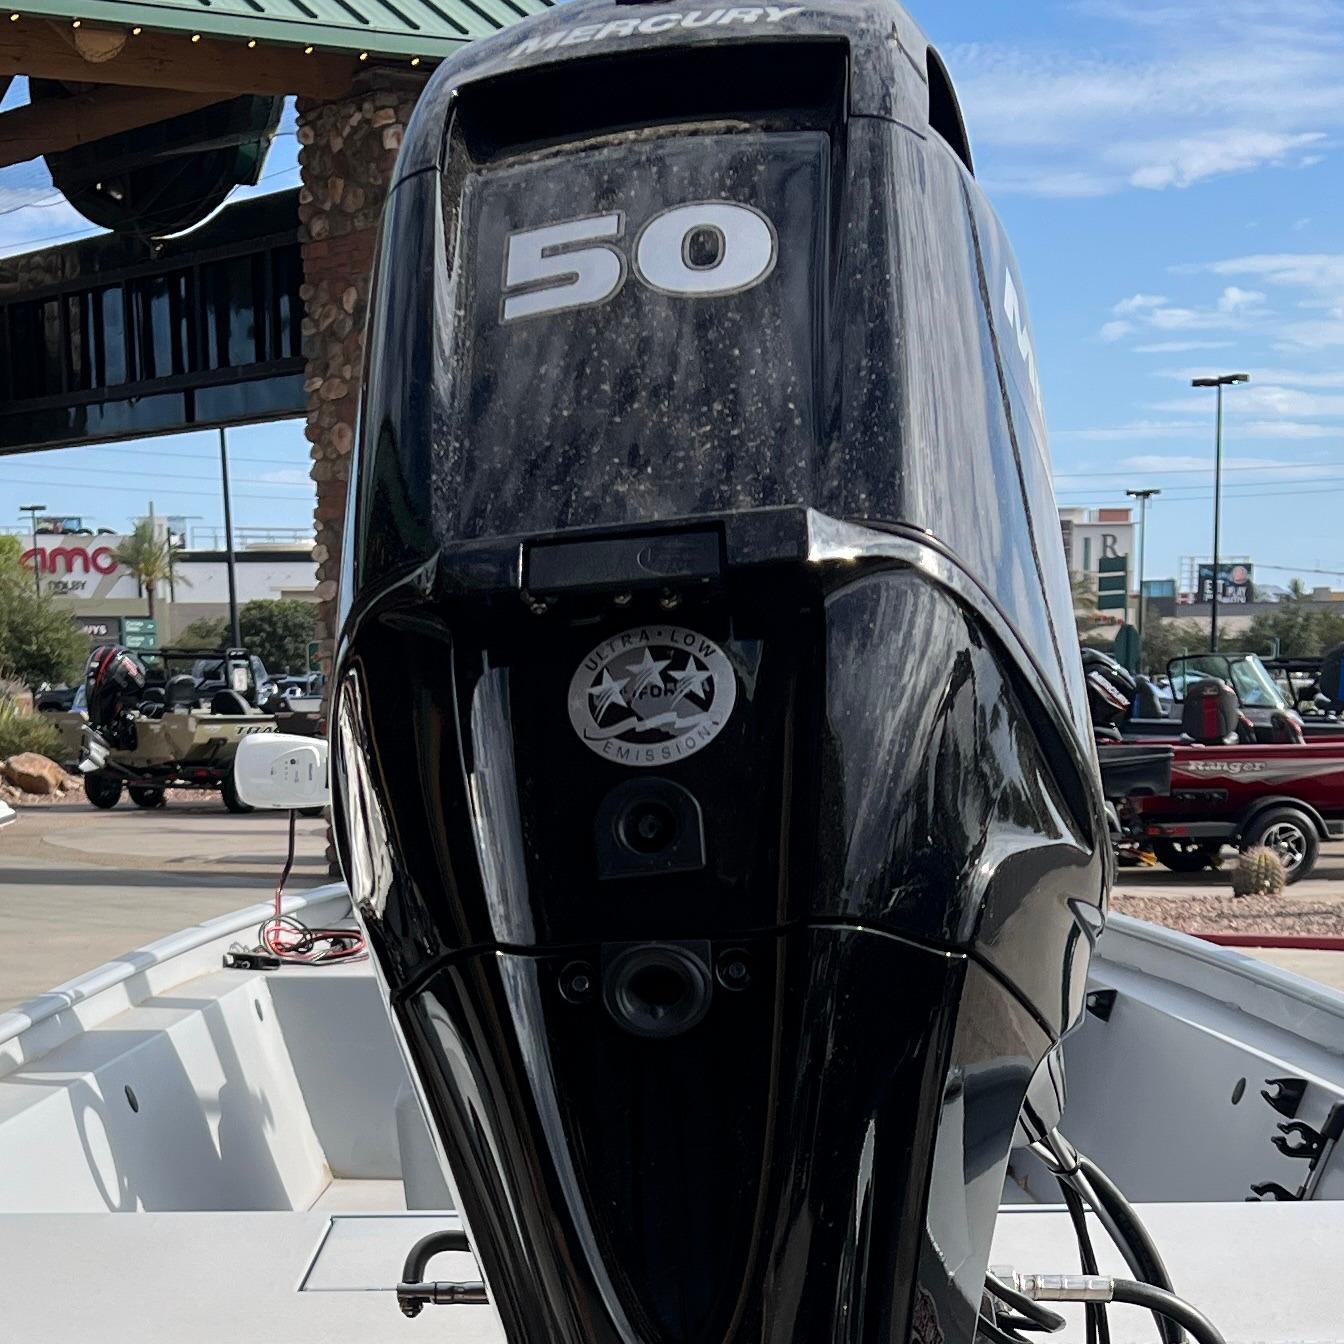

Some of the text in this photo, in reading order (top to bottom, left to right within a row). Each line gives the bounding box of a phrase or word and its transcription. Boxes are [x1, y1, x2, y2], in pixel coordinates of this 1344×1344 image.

[509, 6, 806, 59] MERCURY
[500, 200, 777, 323] 50
[18, 546, 119, 576] amc
[1102, 534, 1127, 557] R
[584, 629, 716, 672] ULTRA LOW
[1188, 759, 1267, 774] Ranger
